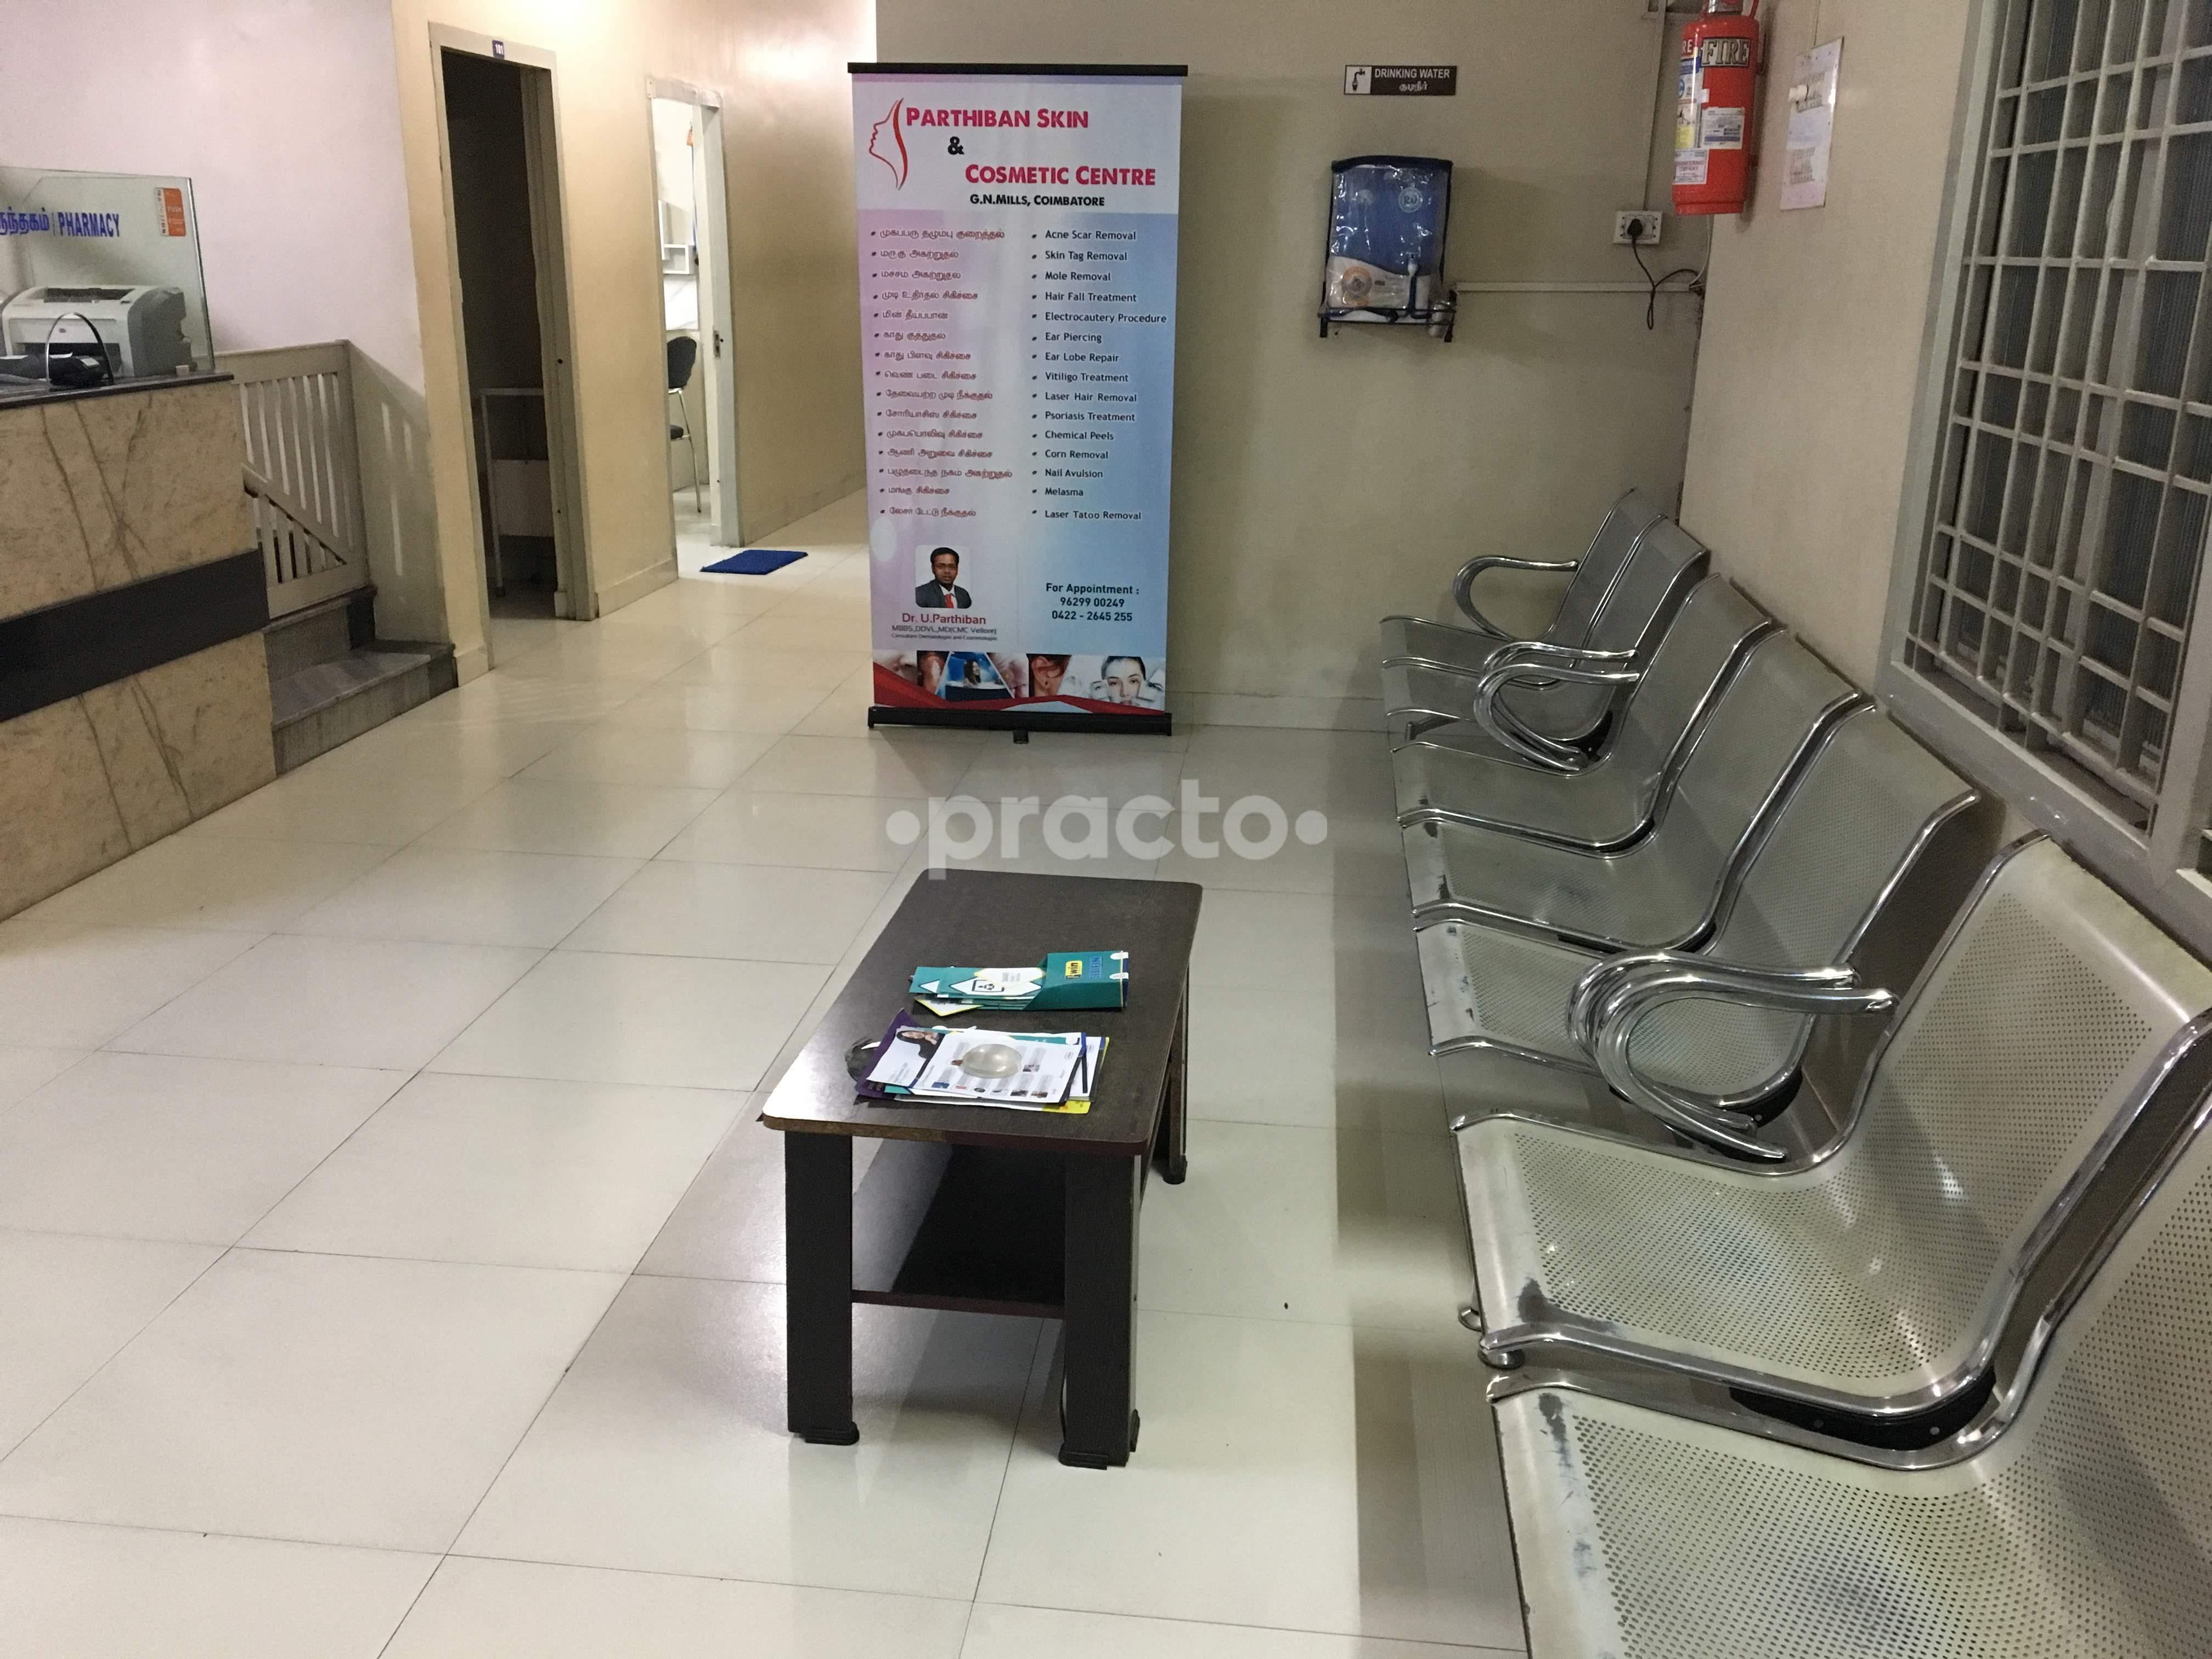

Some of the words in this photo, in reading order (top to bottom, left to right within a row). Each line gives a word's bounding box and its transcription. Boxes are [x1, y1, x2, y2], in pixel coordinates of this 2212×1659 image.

[1702, 39, 1749, 65] FIRE
[1375, 69, 1417, 78] DRINKING
[1419, 69, 1450, 78] WATER
[906, 107, 1030, 128] PARTHIBAN
[1037, 109, 1088, 128] SKIN
[947, 136, 964, 155] &
[966, 165, 1069, 185] COSMETIC
[1076, 166, 1156, 186] CENTRE
[1034, 195, 1105, 206] COIMBATORE
[58, 212, 120, 237] PHARMACY
[1045, 230, 1069, 239] Acne
[1072, 230, 1091, 239] Scar
[1096, 231, 1136, 240] Removal
[1045, 251, 1065, 259] Skin
[1069, 251, 1084, 262] Tag
[1087, 252, 1127, 261] Removal
[1045, 272, 1067, 280] Mole
[1071, 272, 1110, 281] Removal
[1045, 292, 1064, 300] Hair
[1068, 292, 1084, 301] Fall
[1088, 293, 1137, 302] Treatment
[1045, 312, 1115, 323] Electrocautery
[1118, 313, 1167, 323] Procedure
[1045, 332, 1060, 341] Ear
[1064, 333, 1102, 343] Piercing
[1064, 353, 1086, 361] Lobe
[1090, 353, 1119, 363] Repair
[1045, 372, 1077, 382] Vitiligo
[1081, 373, 1128, 382] Treatment
[1045, 392, 1070, 400] Laser
[1074, 393, 1093, 401] Hair
[1098, 393, 1137, 402] Removal
[1045, 411, 1085, 420] Psoriasis
[1087, 412, 1135, 421] Treatment
[1045, 431, 1087, 439] Chemical
[1090, 432, 1114, 440] Peels
[1070, 450, 1108, 459] Removal
[1045, 488, 1084, 496] Melasma
[1045, 510, 1069, 518] Laser
[1073, 511, 1099, 519] Tatoo
[1103, 511, 1141, 520] Removal
[1046, 583, 1063, 592] For
[1066, 584, 1133, 594] Appointment
[1060, 597, 1091, 606] 96299
[1093, 598, 1125, 607] 00249
[902, 613, 917, 622] Dr.
[921, 614, 986, 624] U.Parthiban
[1052, 611, 1076, 619] 0422
[1087, 612, 1111, 620] 2645
[1114, 612, 1132, 621] 255
